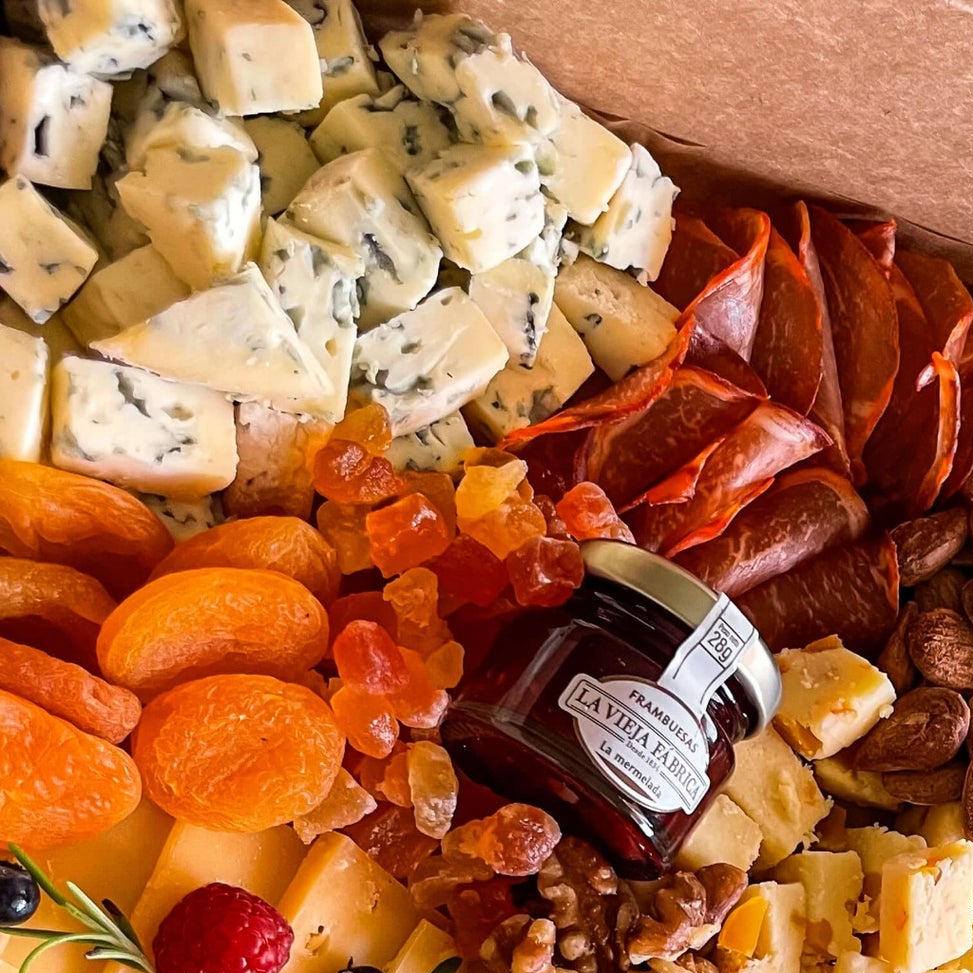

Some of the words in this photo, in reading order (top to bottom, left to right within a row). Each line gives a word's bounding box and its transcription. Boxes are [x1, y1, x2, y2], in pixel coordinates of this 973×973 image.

[707, 630, 733, 663] 28g
[575, 687, 604, 715] LA
[603, 703, 651, 749] VIEJA
[651, 741, 702, 800] FÁBRICA
[629, 689, 699, 754] FRAMBUESAS
[600, 740, 613, 756] La
[614, 753, 662, 799] mermelada
